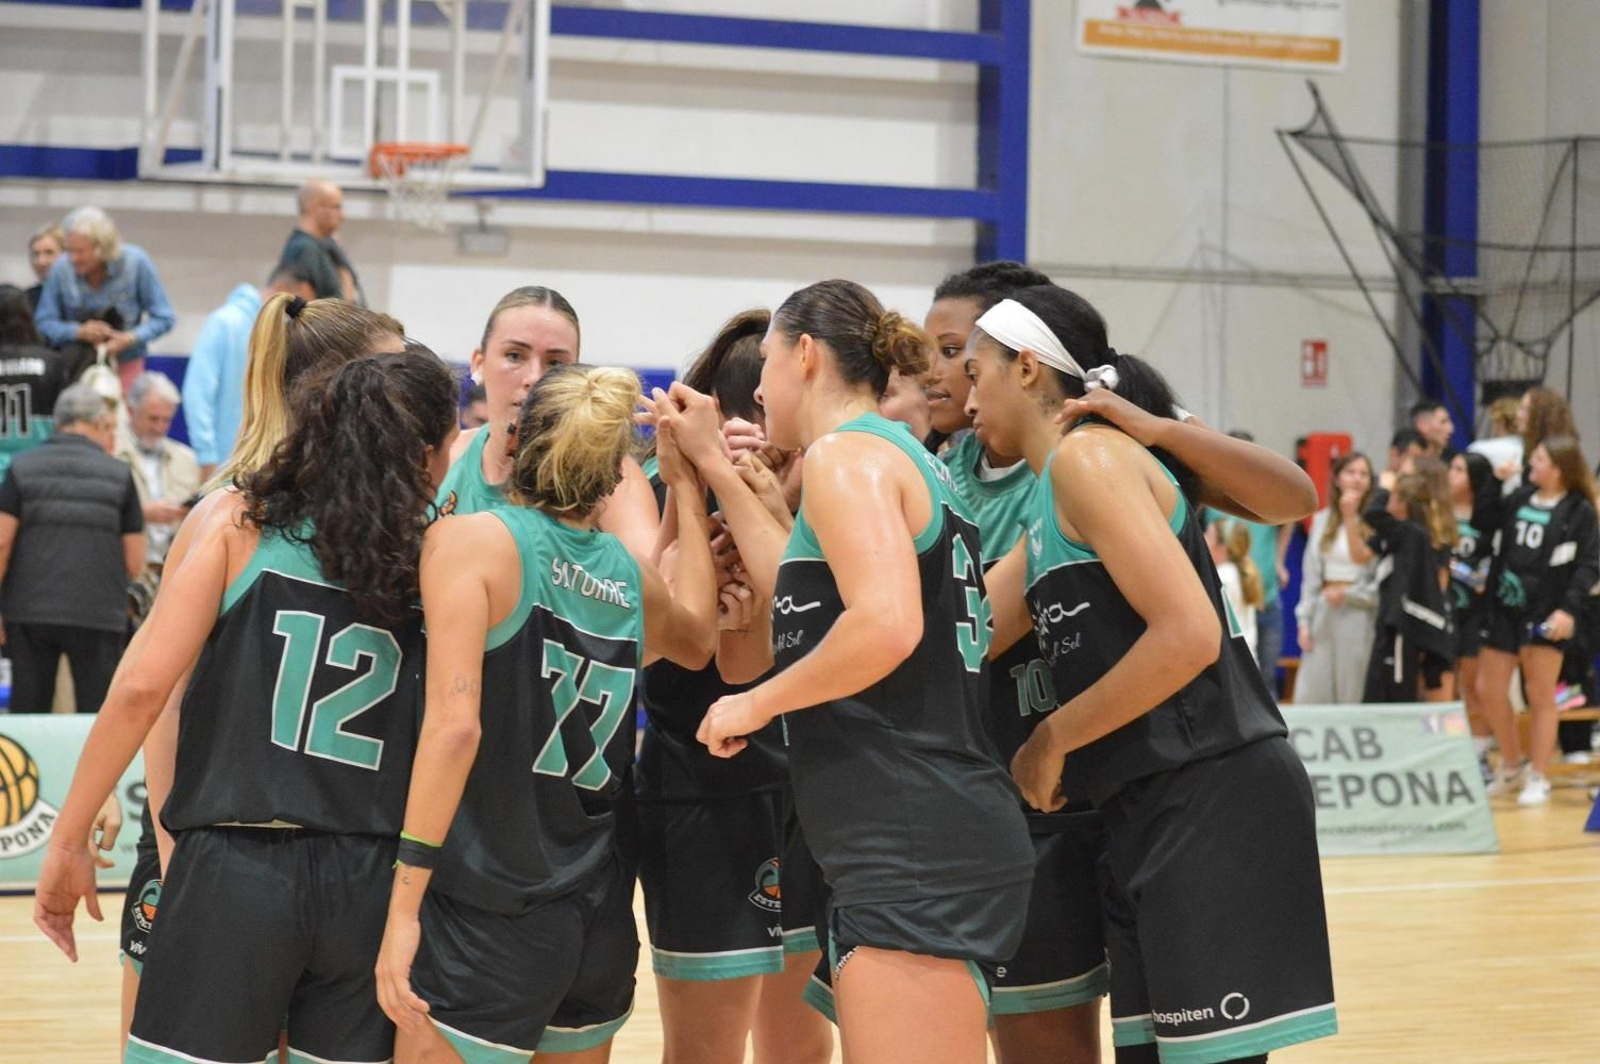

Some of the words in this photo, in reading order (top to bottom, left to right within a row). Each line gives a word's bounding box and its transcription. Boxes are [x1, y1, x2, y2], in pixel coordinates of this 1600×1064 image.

[1515, 520, 1545, 550] 10
[271, 609, 403, 772] 12
[532, 637, 636, 792] 77
[1009, 657, 1060, 717] 10
[1290, 726, 1385, 763] CAB
